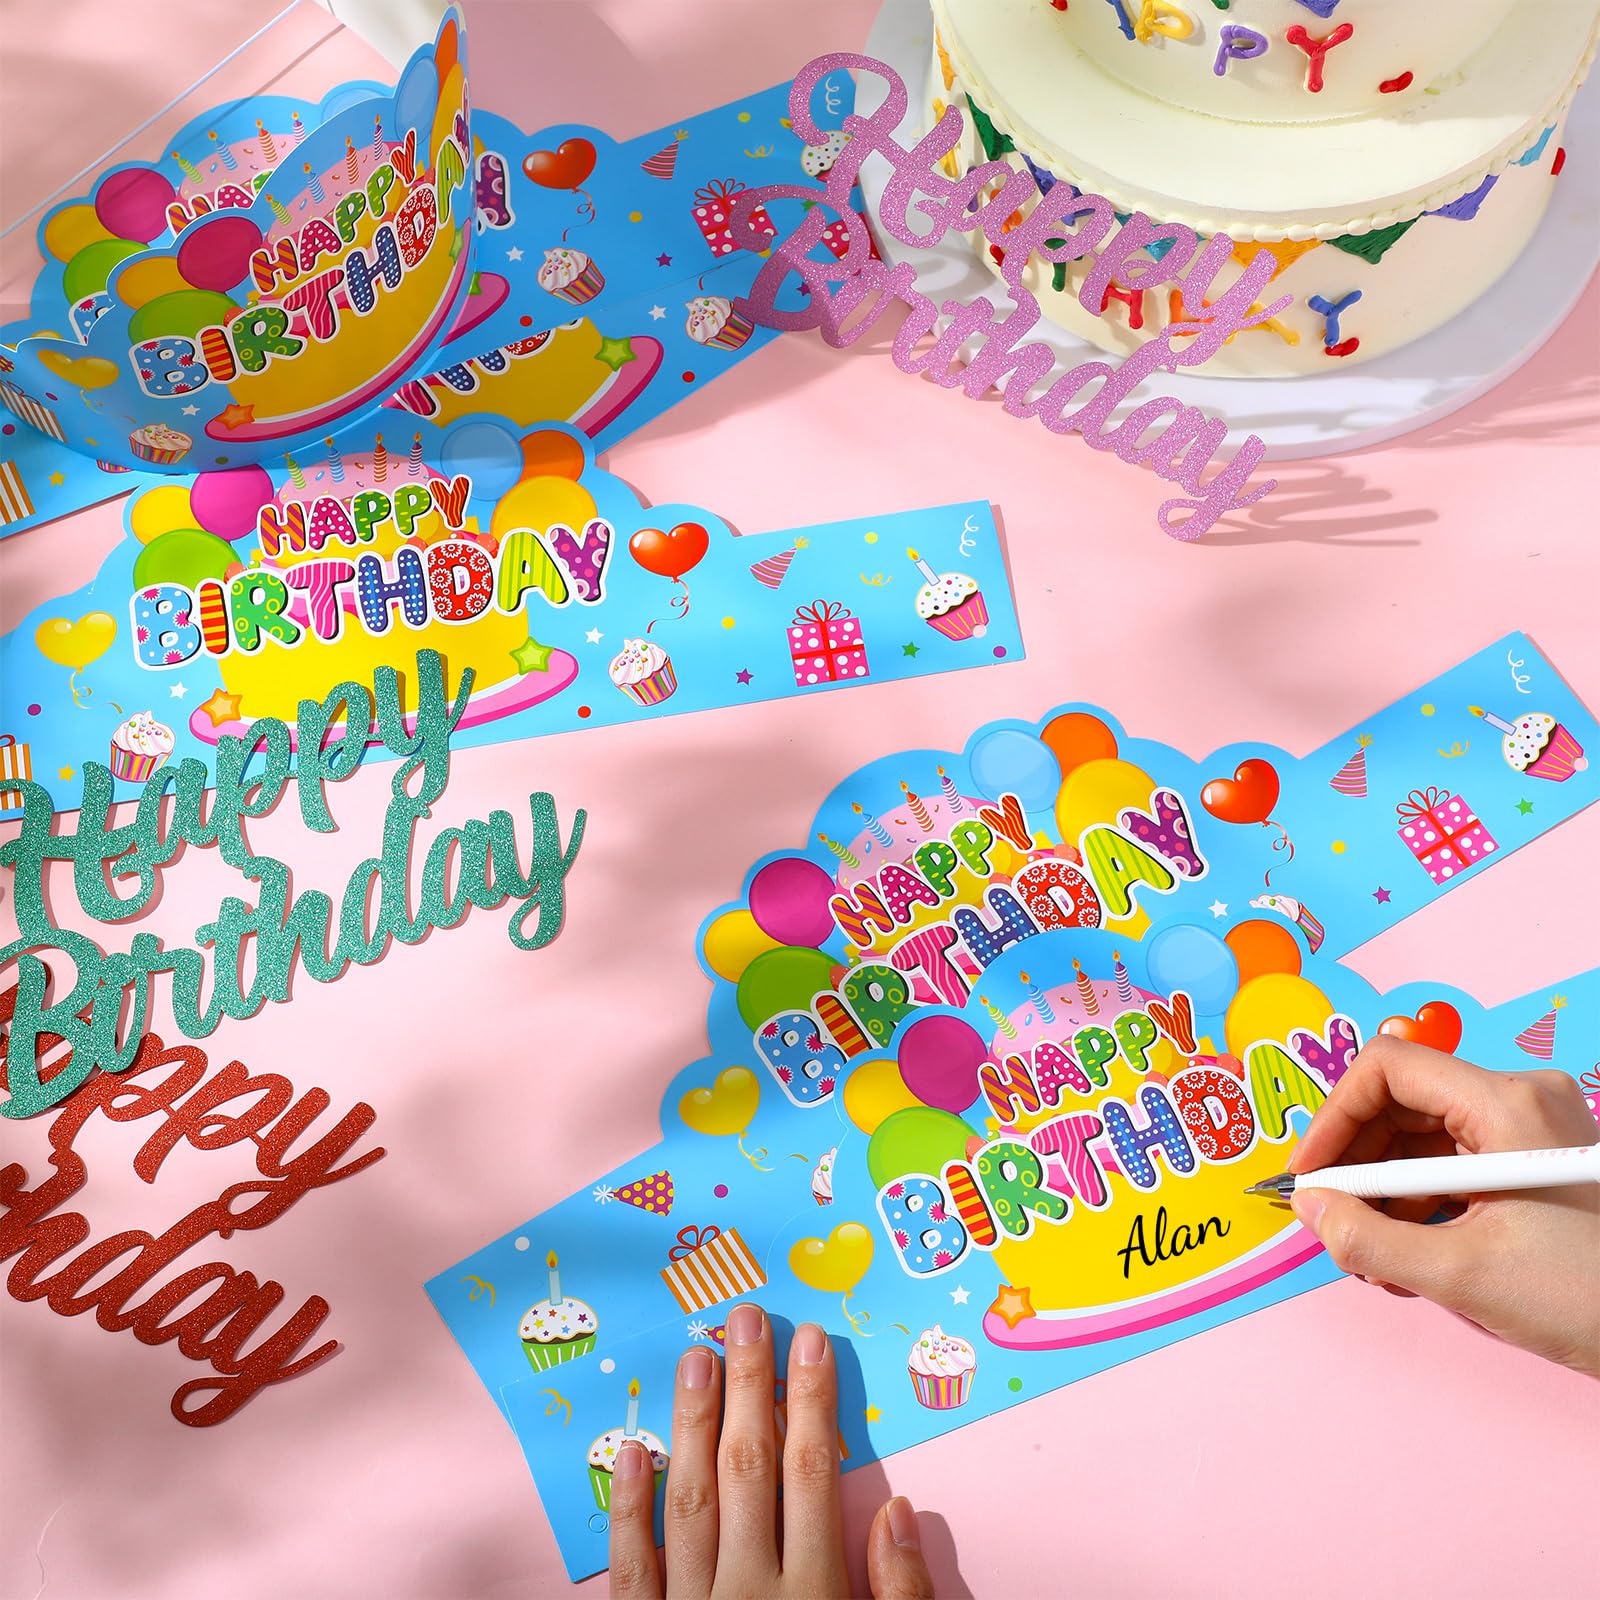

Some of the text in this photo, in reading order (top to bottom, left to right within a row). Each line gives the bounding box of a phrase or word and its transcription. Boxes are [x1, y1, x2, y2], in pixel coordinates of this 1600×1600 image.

[248, 128, 417, 294] HAPPY
[789, 52, 1294, 367] Happy
[729, 183, 1278, 542] Birthday
[129, 517, 615, 671] BIRTHDAY
[256, 474, 473, 558] HAPPY
[753, 786, 1210, 1108] BIRTHDAY
[828, 792, 1034, 950] HAPPY
[977, 990, 1200, 1125] HAPPY
[1116, 1205, 1231, 1279] Alan
